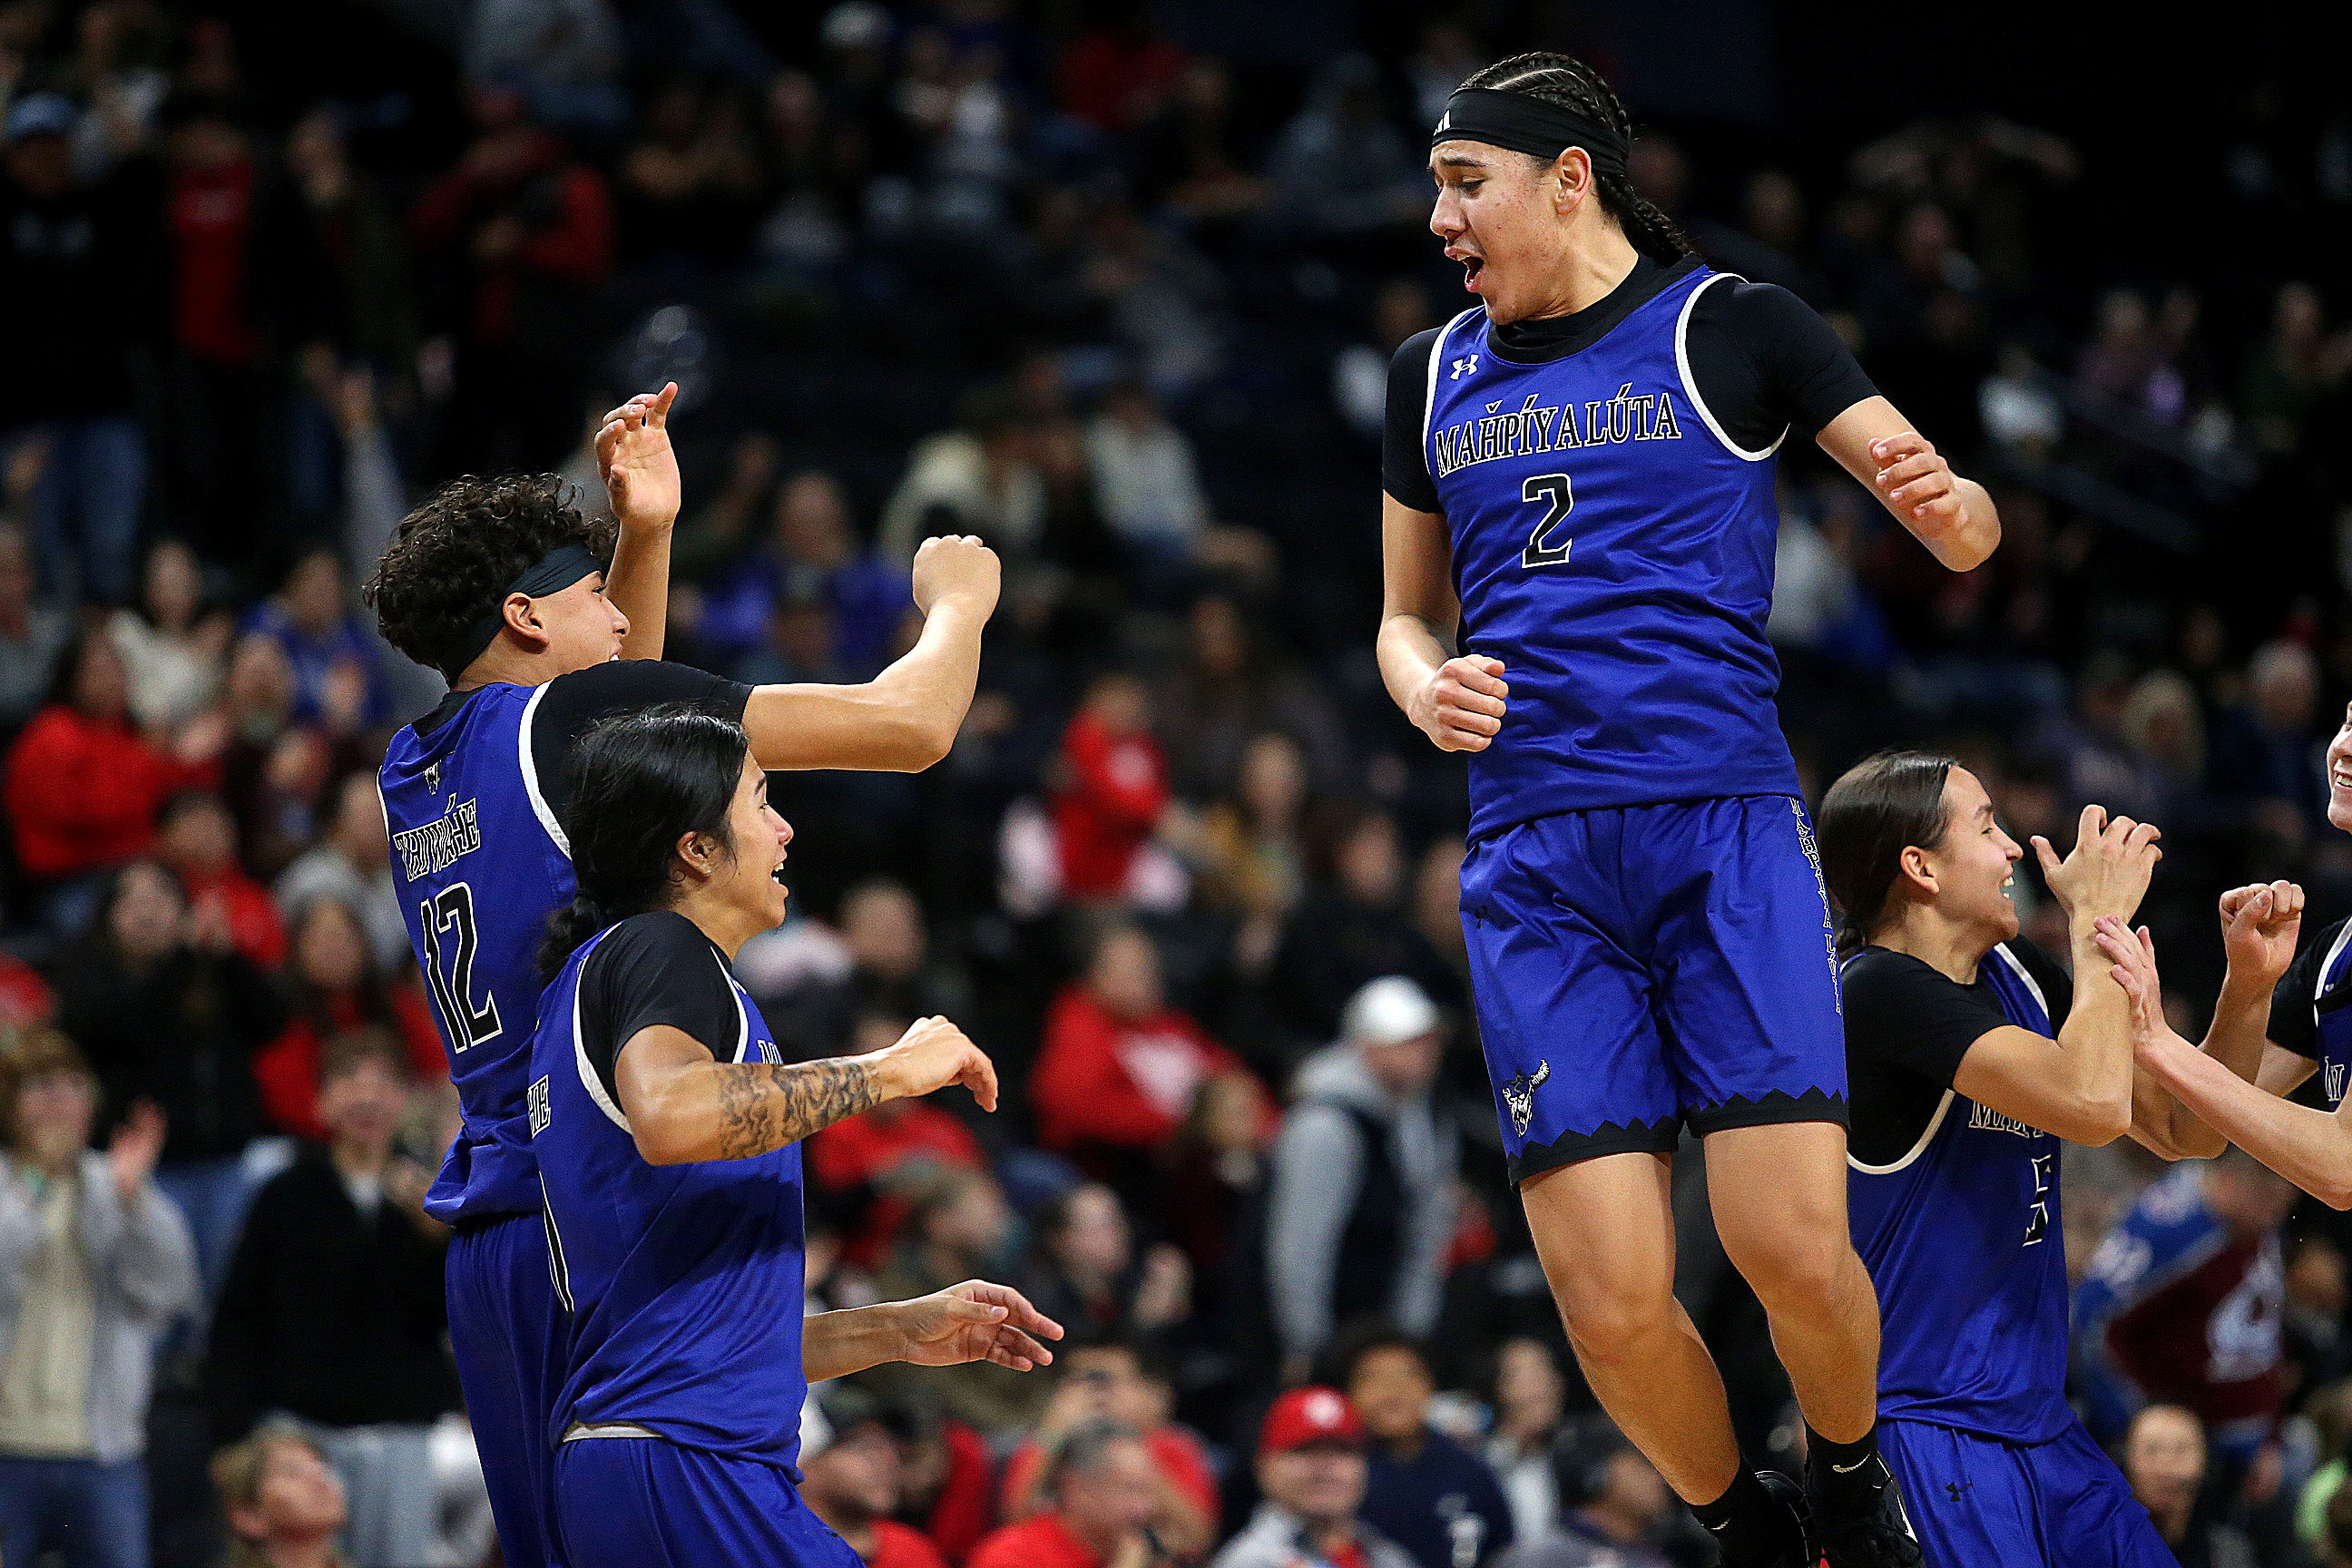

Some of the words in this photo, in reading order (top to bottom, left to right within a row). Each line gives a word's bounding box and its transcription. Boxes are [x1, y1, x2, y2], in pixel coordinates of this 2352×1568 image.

[1521, 473, 1574, 569] 2
[421, 881, 503, 1054] 12
[2023, 1154, 2052, 1247] 5
